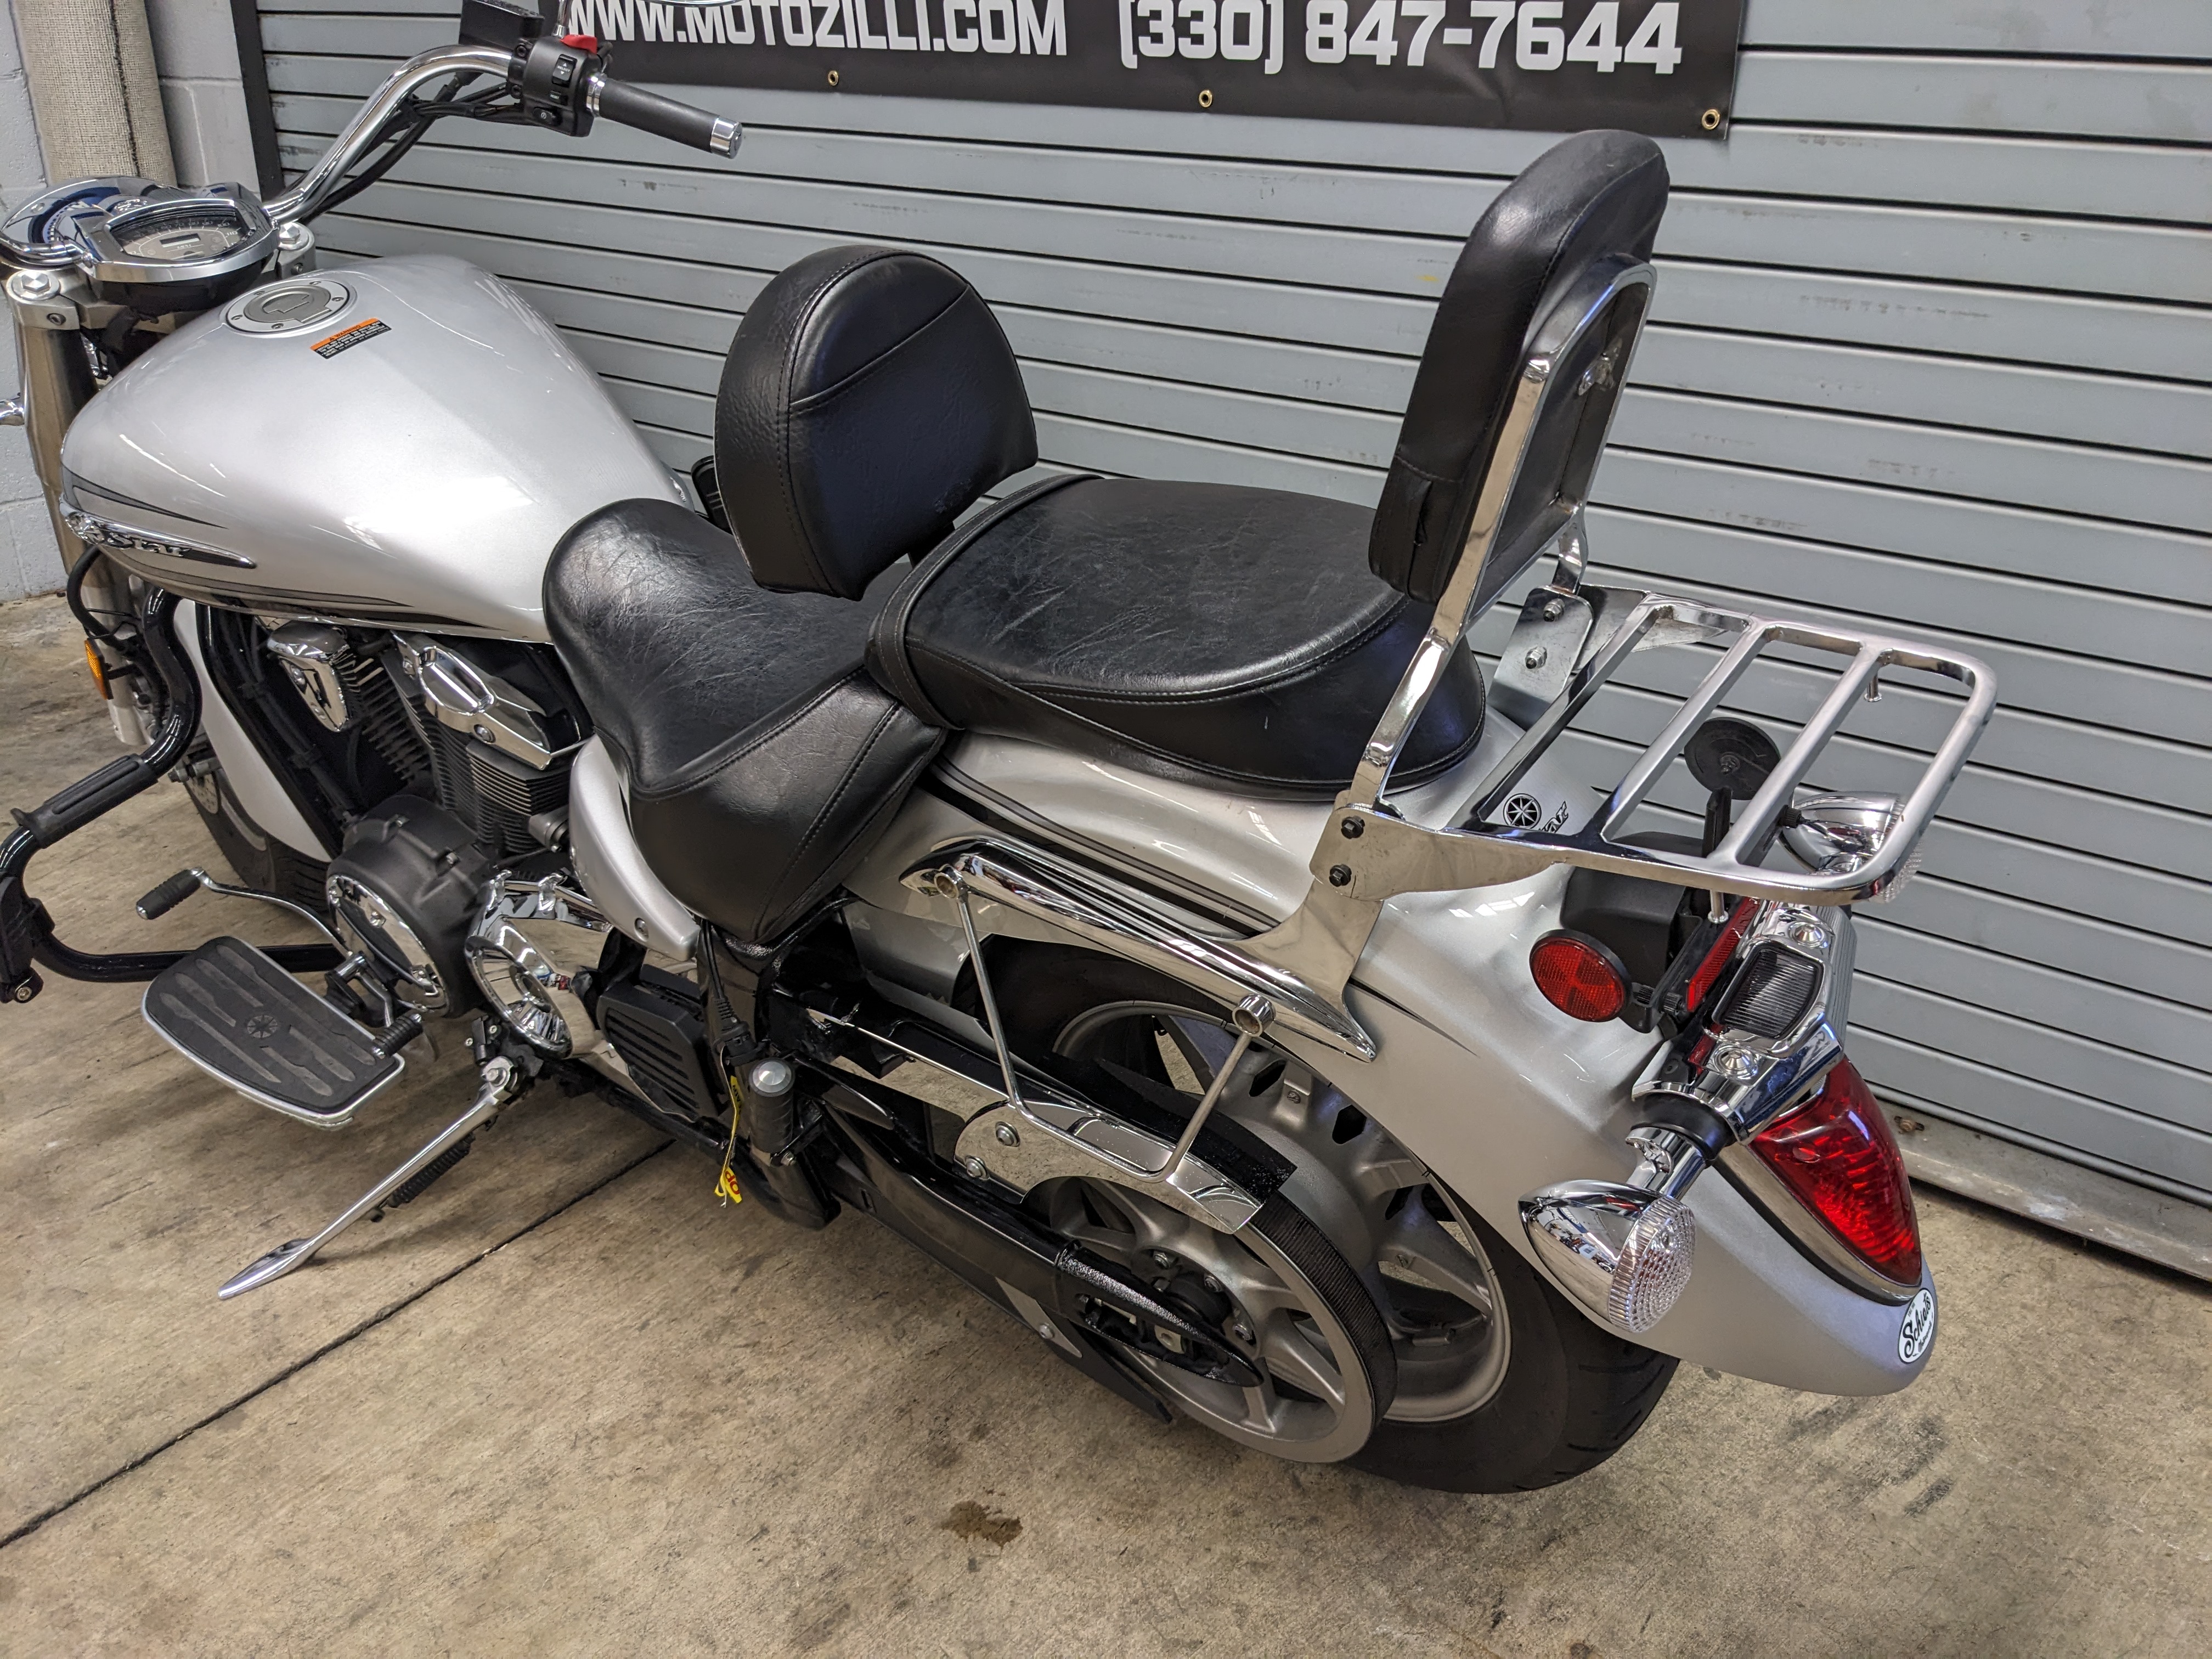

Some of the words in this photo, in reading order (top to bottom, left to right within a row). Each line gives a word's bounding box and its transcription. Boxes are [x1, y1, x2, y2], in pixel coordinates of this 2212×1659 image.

[559, 0, 1066, 55] WWW.MOTOZILLI.COM
[1305, 0, 1683, 75] 847-7644
[334, 325, 361, 337] WARNING
